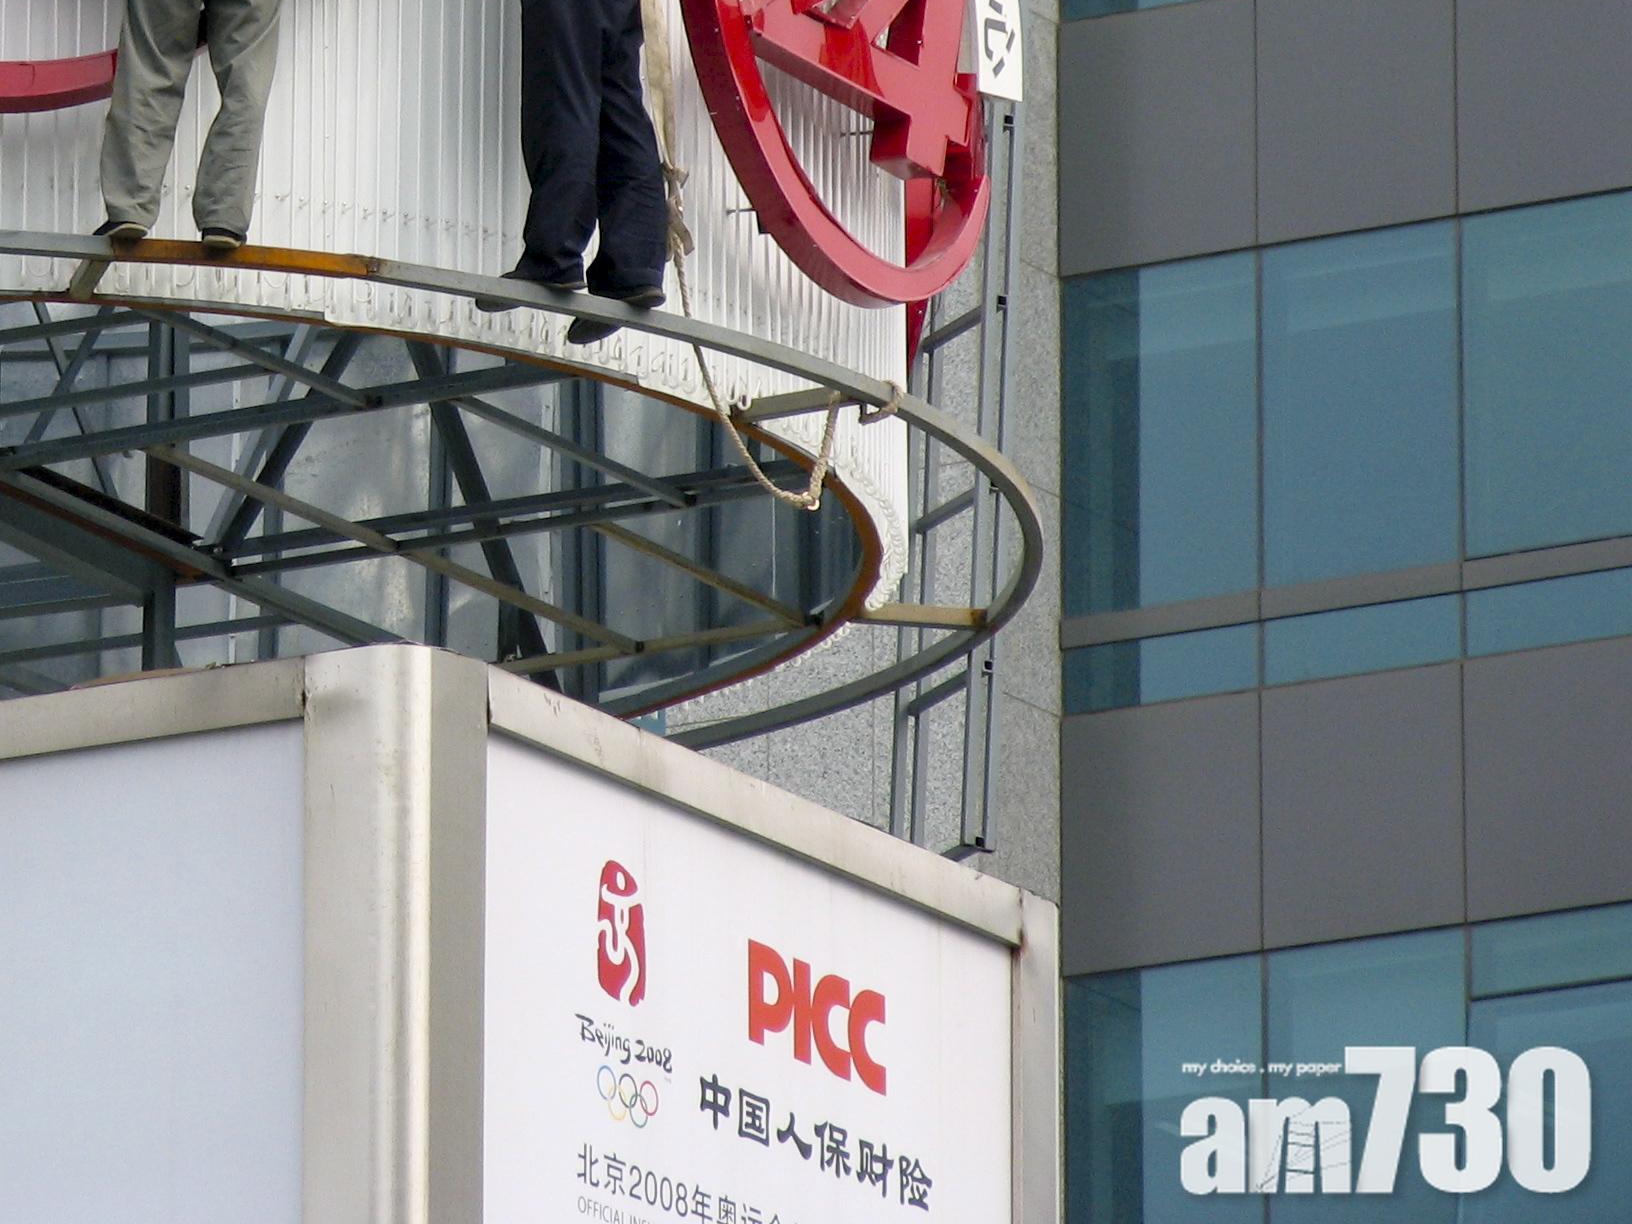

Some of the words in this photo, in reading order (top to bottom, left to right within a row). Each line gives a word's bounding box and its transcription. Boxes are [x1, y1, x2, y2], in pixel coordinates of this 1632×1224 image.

[574, 1013, 631, 1065] Beijing
[635, 1039, 672, 1073] 2008
[748, 938, 887, 1096] PICC
[699, 1073, 933, 1212] 中国人保财险
